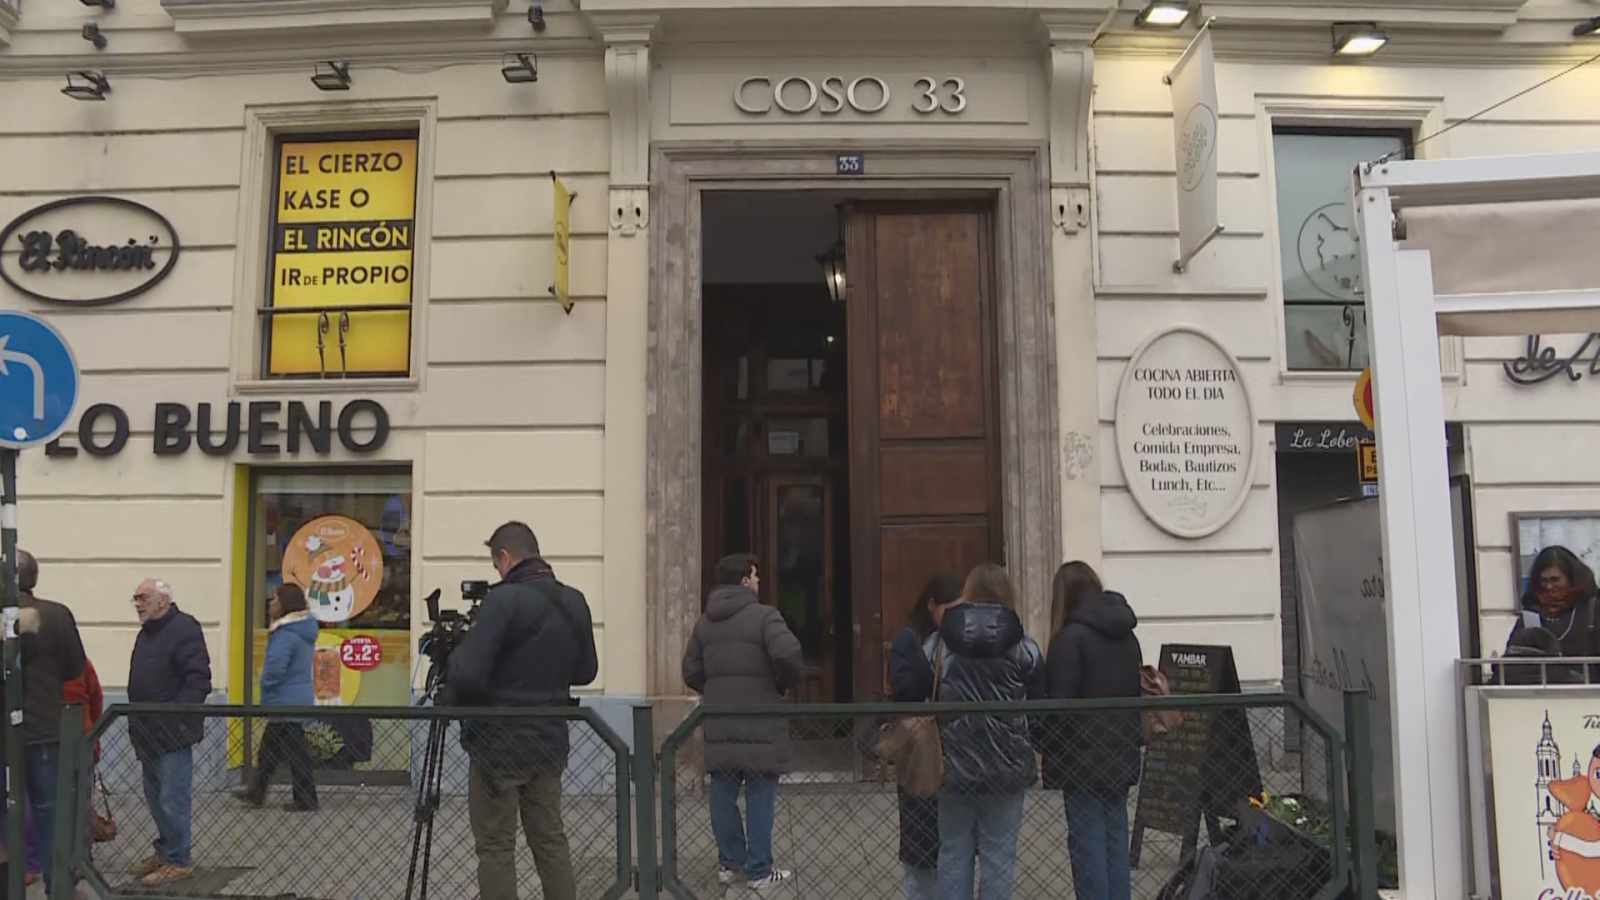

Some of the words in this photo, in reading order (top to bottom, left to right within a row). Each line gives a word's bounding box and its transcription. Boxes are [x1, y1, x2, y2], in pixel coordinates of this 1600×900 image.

[734, 75, 890, 114] COSO
[912, 76, 967, 115] 33
[285, 155, 309, 175] EL
[318, 152, 403, 174] CIERZO
[839, 156, 859, 171] 33
[283, 189, 341, 210] KASE
[350, 188, 370, 208] O
[284, 229, 308, 250] EL
[317, 221, 408, 249] RINCÓN
[281, 268, 301, 286] IR
[303, 276, 318, 286] DE
[322, 265, 409, 286] PROPIO
[1134, 368, 1181, 382] COCINA
[1185, 369, 1236, 382] ABIERTA
[1147, 386, 1181, 400] TODO
[1185, 387, 1200, 400] EL
[1203, 386, 1225, 400] DIA
[153, 399, 390, 457] BUENO
[1142, 422, 1231, 437] Celebraciones,
[1290, 428, 1313, 448] La
[1133, 441, 1180, 455] Comida
[1184, 441, 1241, 457] Empresa,
[1140, 460, 1181, 474] Bodas,
[1185, 460, 1237, 473] Bautizos
[1151, 478, 1192, 492] Lunch,
[1196, 478, 1226, 491] Etc...
[1177, 652, 1207, 666] AMBAR
